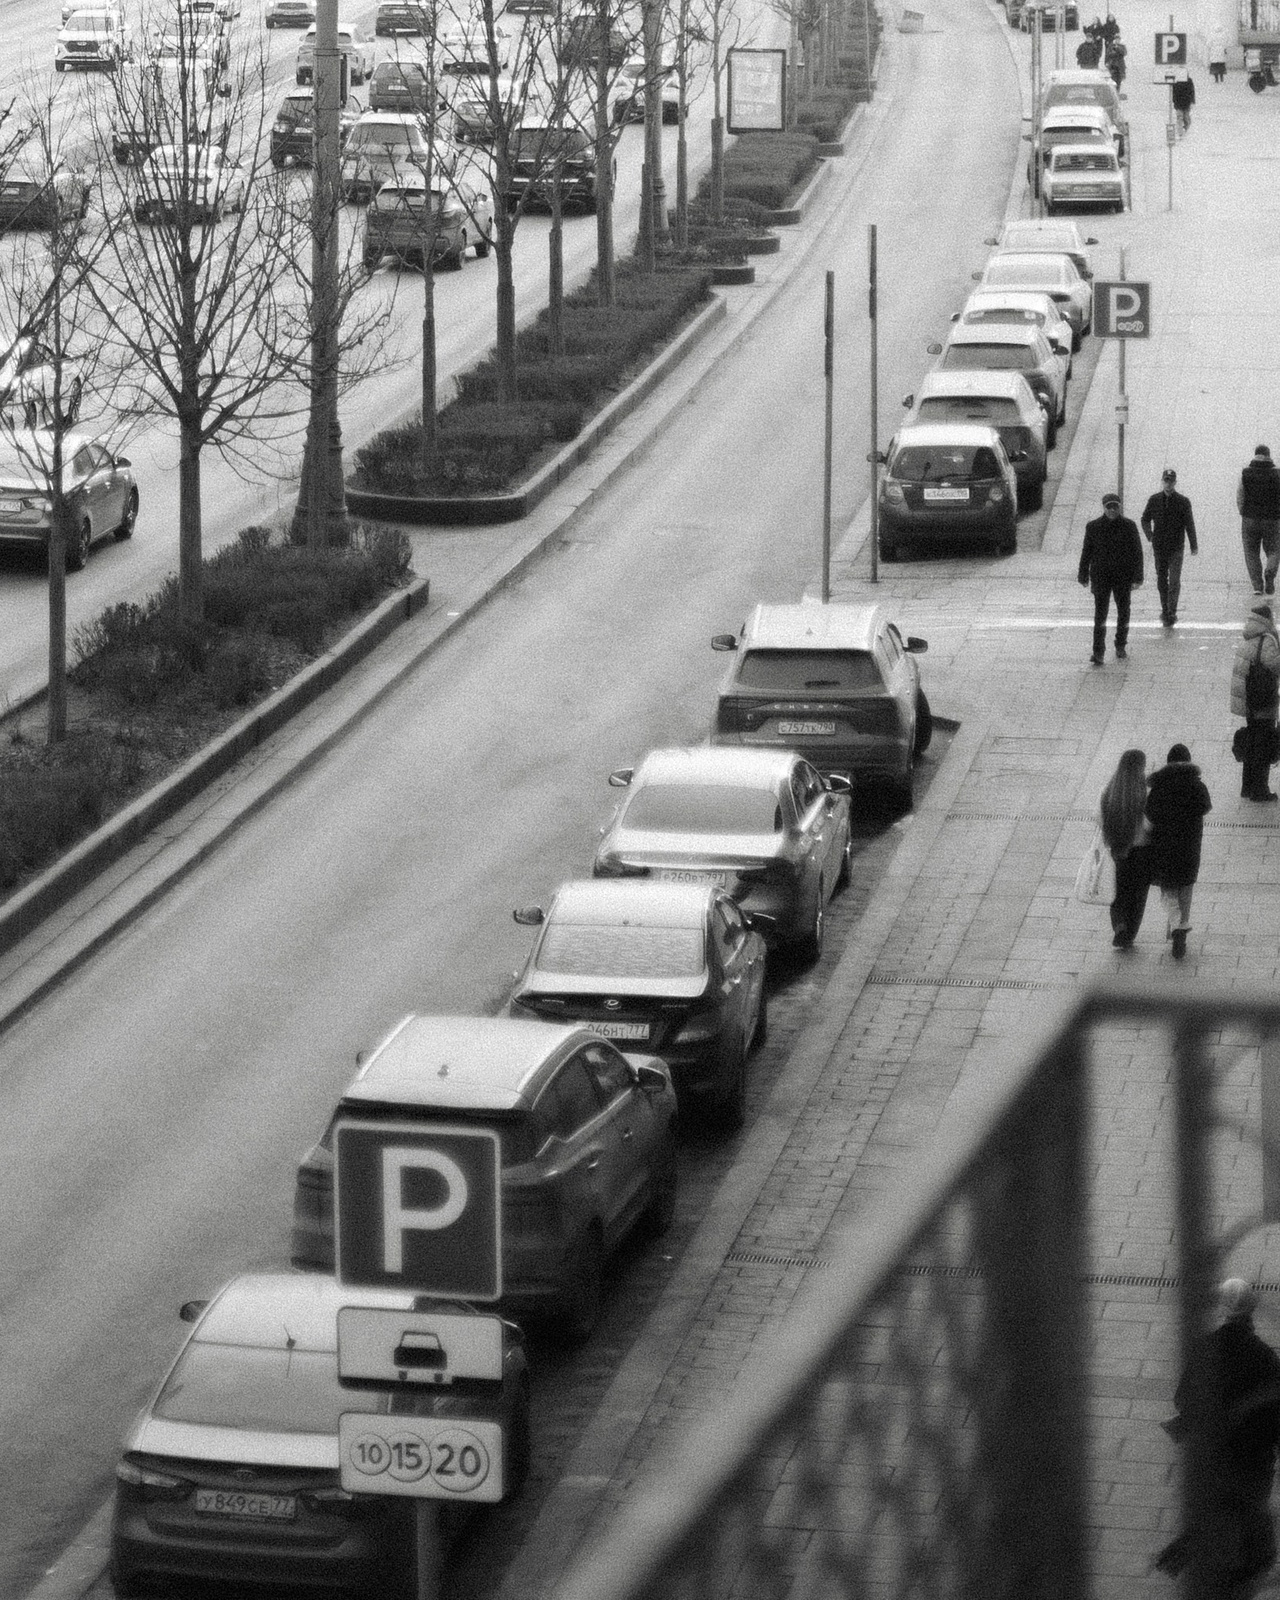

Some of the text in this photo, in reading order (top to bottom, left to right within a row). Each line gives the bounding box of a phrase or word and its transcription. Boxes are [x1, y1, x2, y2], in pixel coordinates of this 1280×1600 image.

[1162, 34, 1180, 63] P
[1109, 287, 1141, 333] P
[381, 1146, 468, 1274] P
[357, 1442, 482, 1478] 10 15 20
